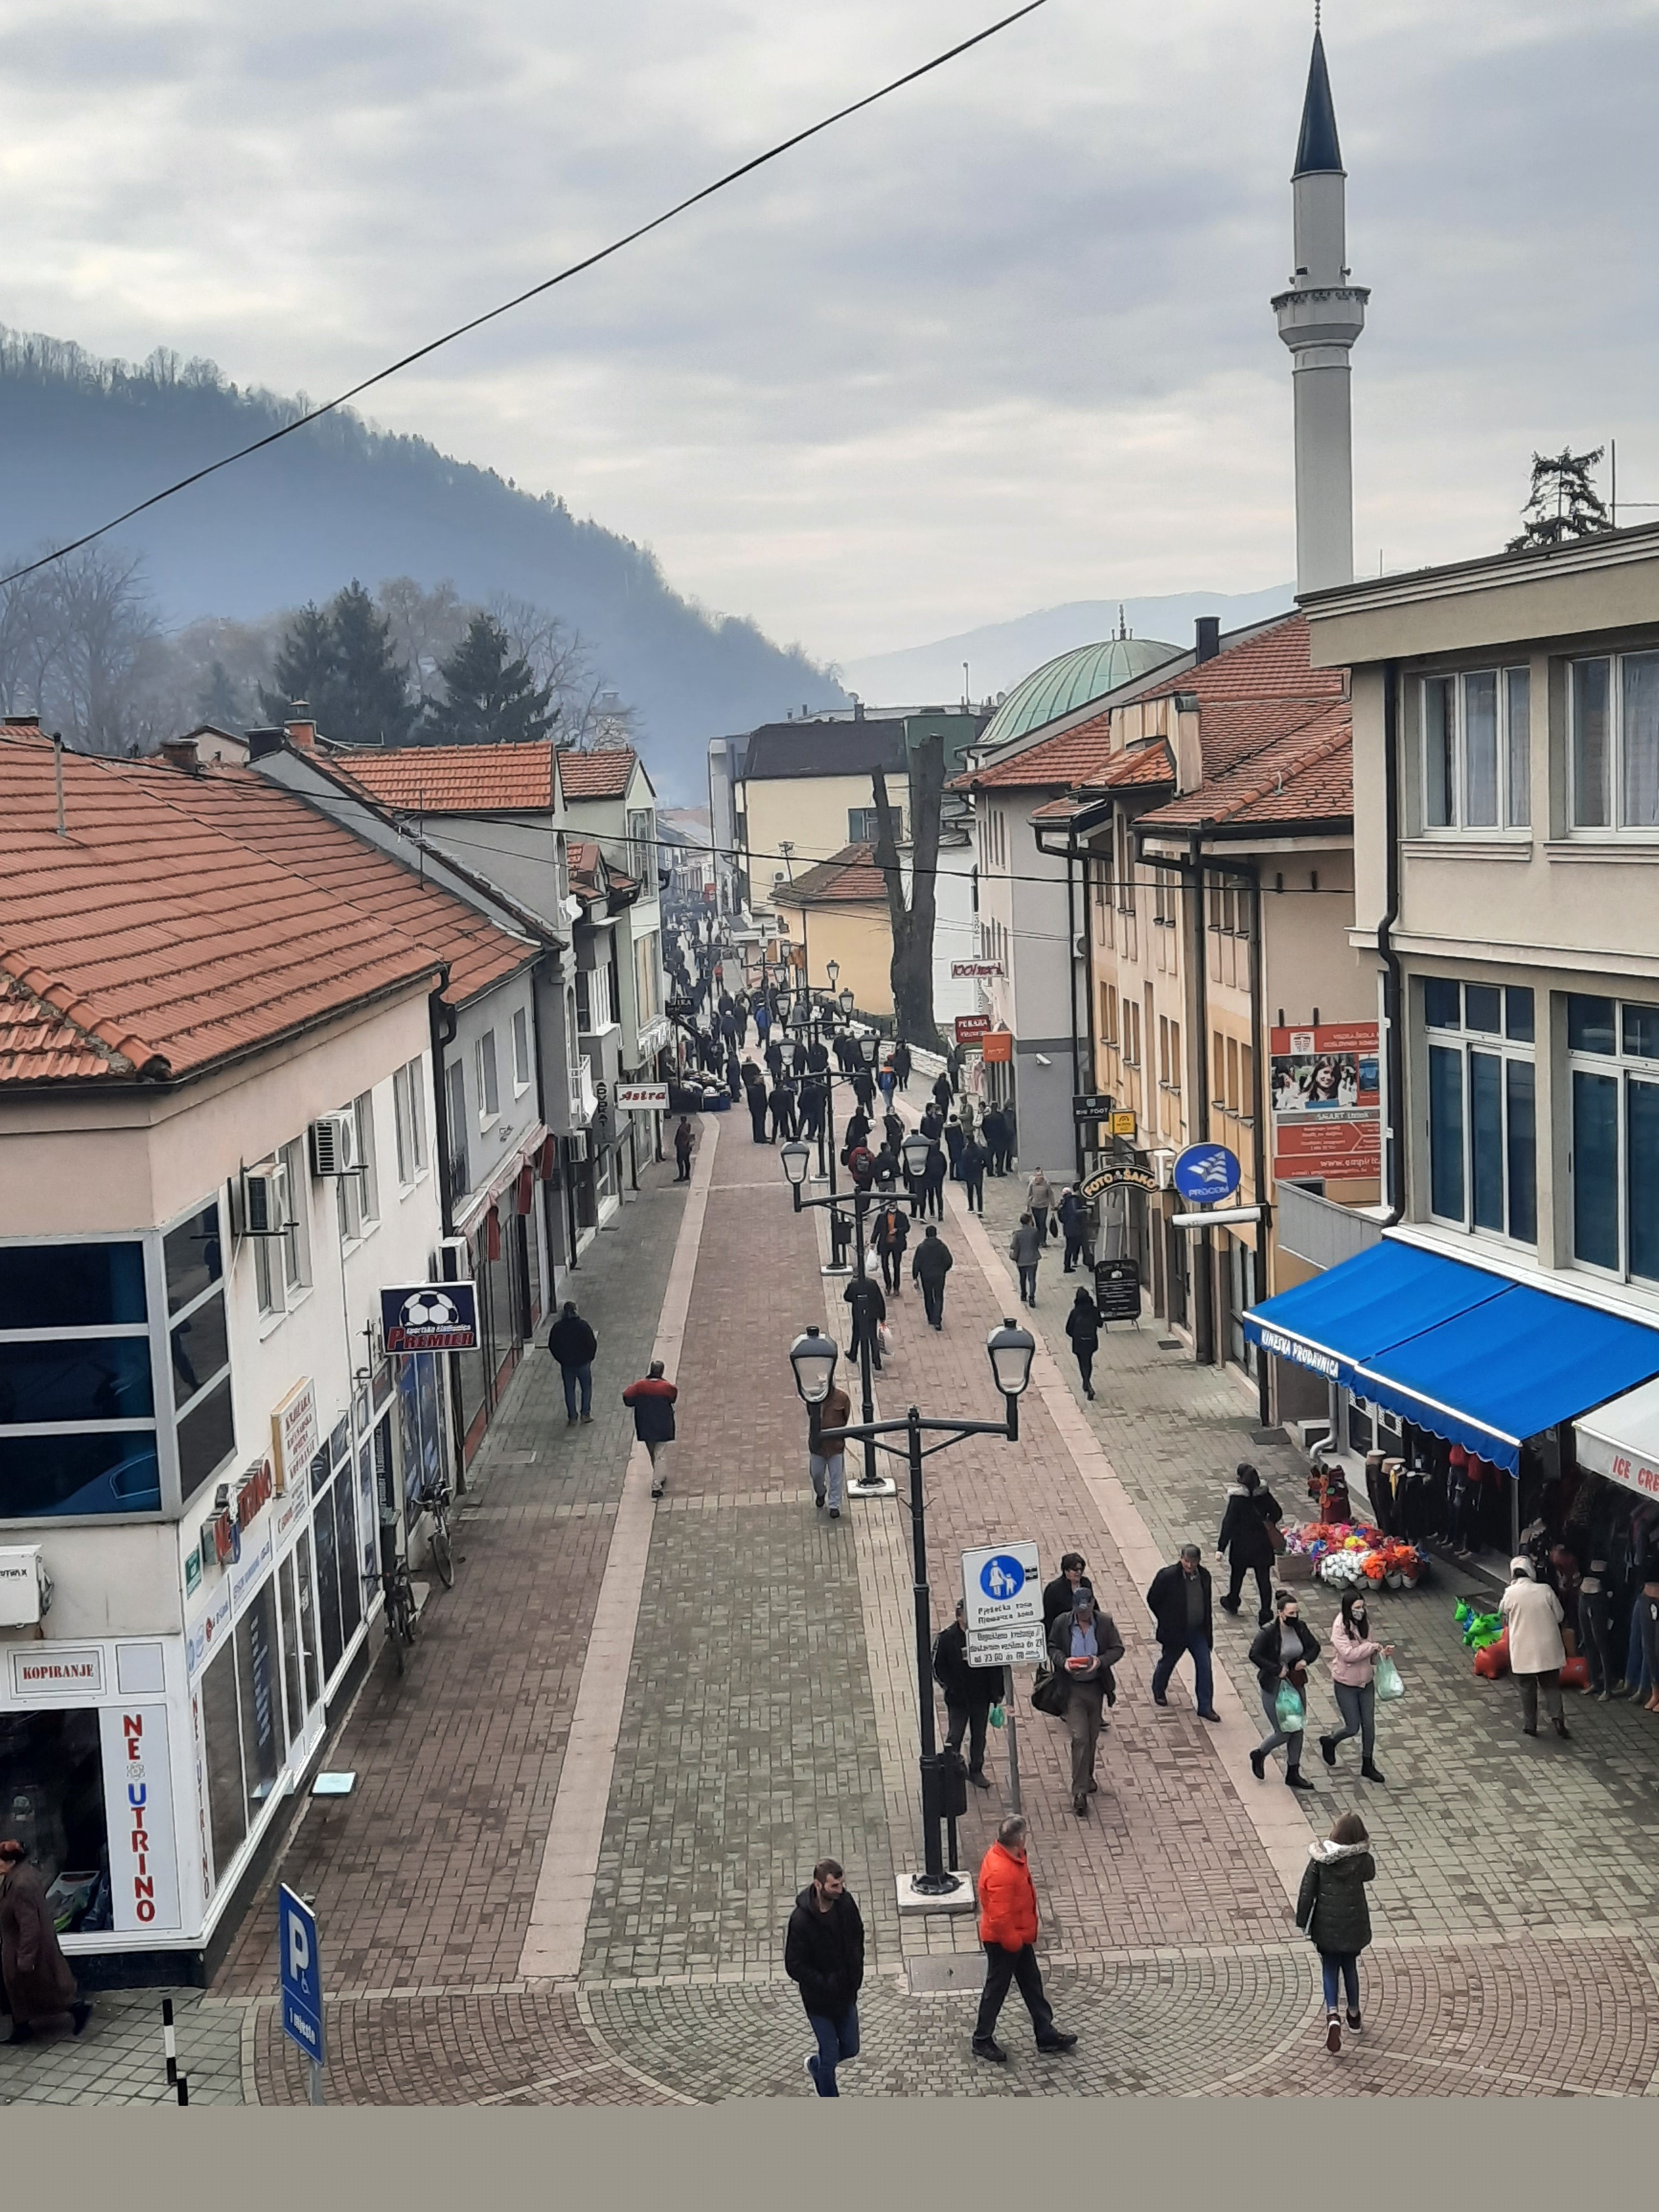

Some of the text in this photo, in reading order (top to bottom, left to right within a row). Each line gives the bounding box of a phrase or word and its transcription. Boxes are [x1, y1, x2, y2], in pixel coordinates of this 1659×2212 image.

[619, 1091, 665, 1101] Astra
[1084, 1167, 1156, 1196] FOTO ŠAKO
[388, 1326, 474, 1350] PREMIER
[1261, 1328, 1339, 1378] KINESKA PRODAVNICA
[1612, 1455, 1632, 1480] ICE
[23, 1663, 94, 1679] KOPIRANJE
[123, 1714, 155, 1922] NEUTRINO
[288, 1909, 310, 1982] P
